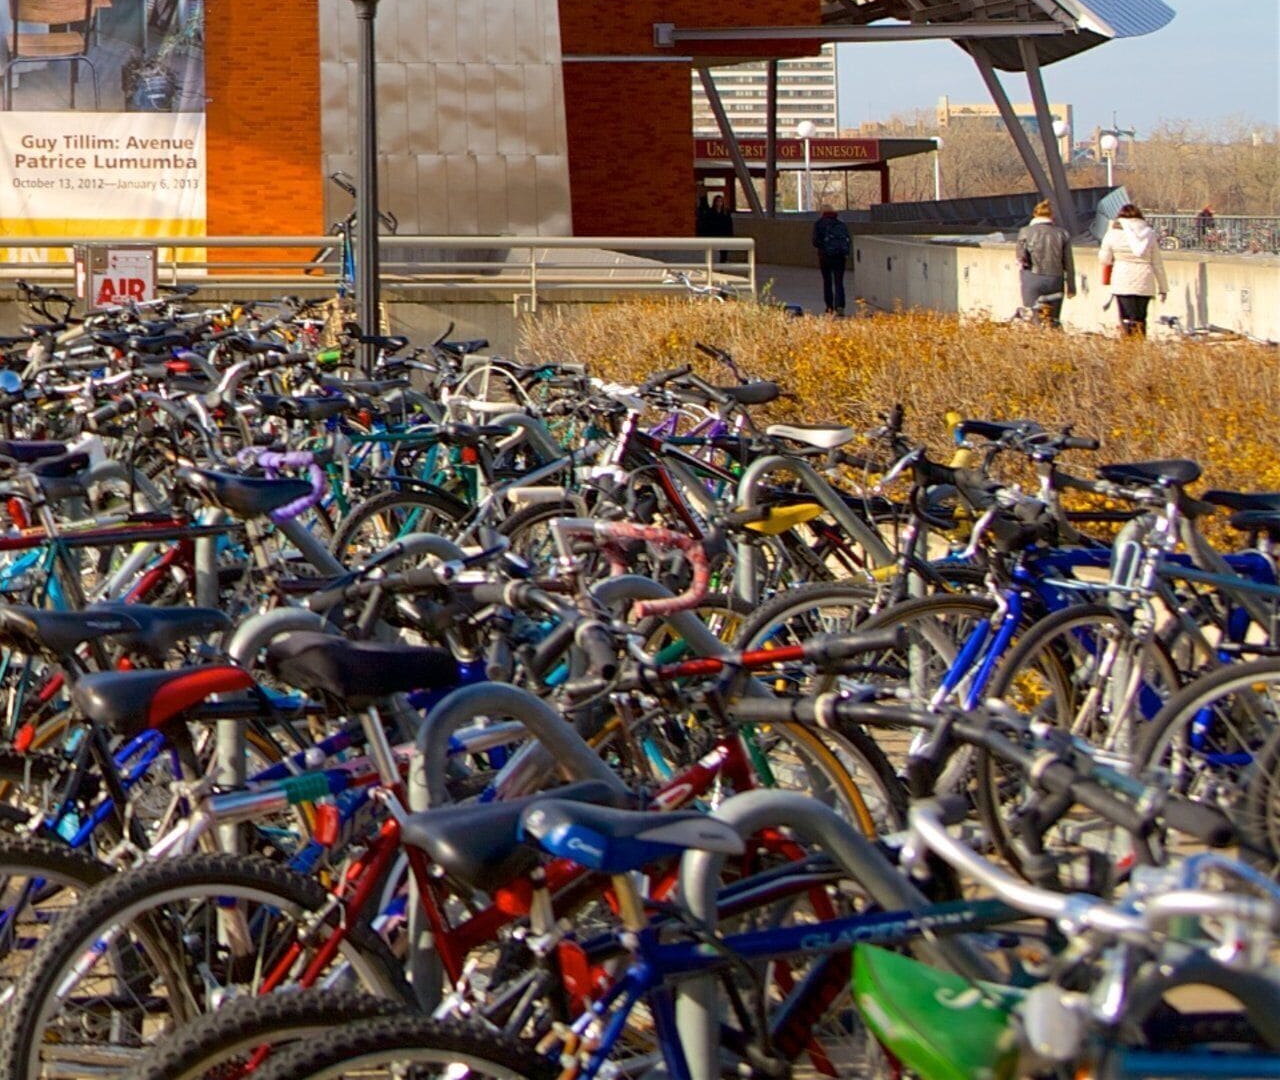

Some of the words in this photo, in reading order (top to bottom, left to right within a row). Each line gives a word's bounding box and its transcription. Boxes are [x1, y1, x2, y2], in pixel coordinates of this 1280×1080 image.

[21, 134, 57, 152] Guy
[63, 135, 120, 150] Tillim:
[126, 136, 194, 151] Avenue
[706, 142, 777, 157] UNIERSIT
[781, 147, 798, 157] OF
[15, 154, 86, 169] Patrice
[94, 154, 198, 169] Lumumba
[12, 177, 54, 189] October
[60, 178, 74, 190] 13,
[174, 178, 199, 190] 2013
[96, 278, 146, 306] AIR
